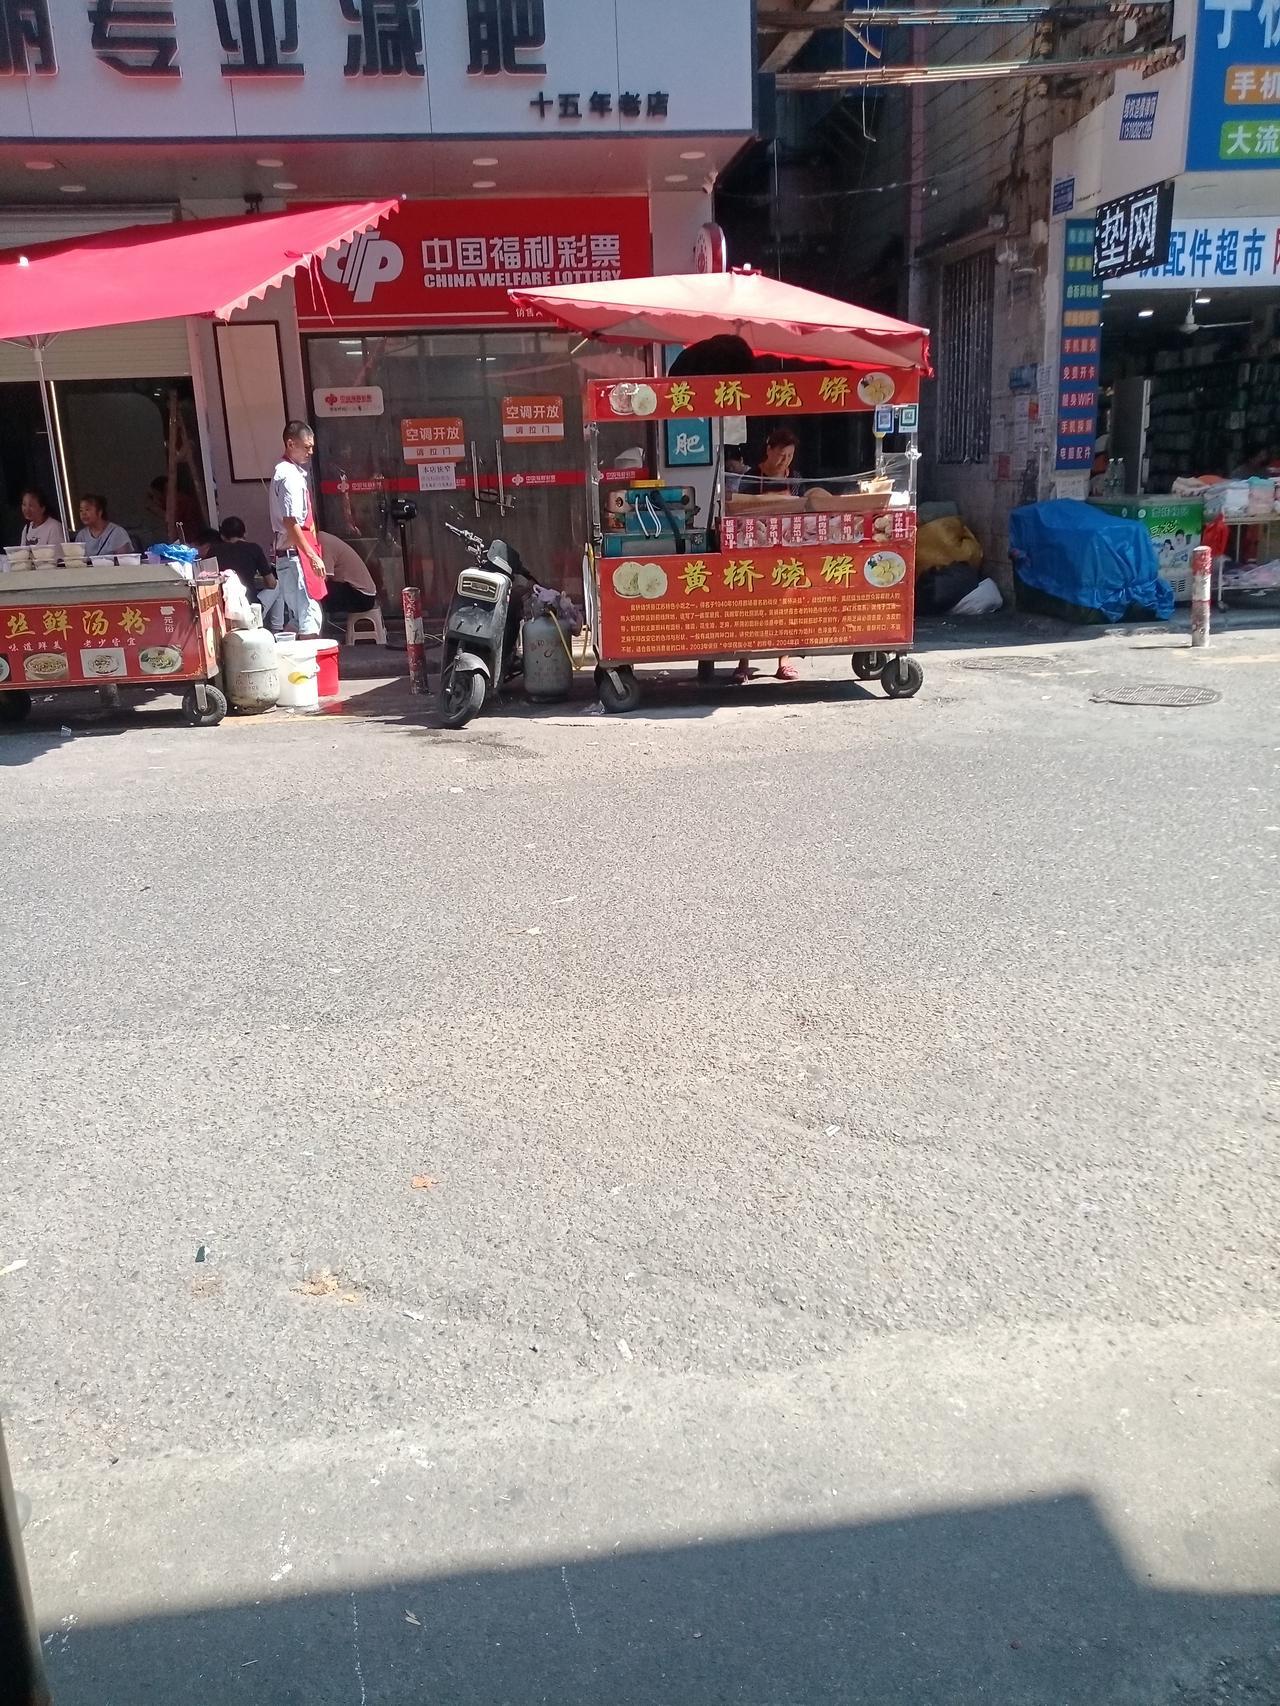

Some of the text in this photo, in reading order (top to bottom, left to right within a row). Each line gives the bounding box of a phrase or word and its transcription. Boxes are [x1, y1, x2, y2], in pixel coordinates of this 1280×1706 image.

[530, 91, 669, 119] 十五年老店
[421, 234, 621, 271] 中国福利彩票
[424, 271, 475, 288] CHINA
[479, 271, 551, 287] WELFARE
[664, 376, 851, 413] 黄桥烧饼
[505, 404, 560, 419] 空调开放
[406, 426, 460, 441] 空调开放
[678, 555, 857, 596] 黄桥烧饼
